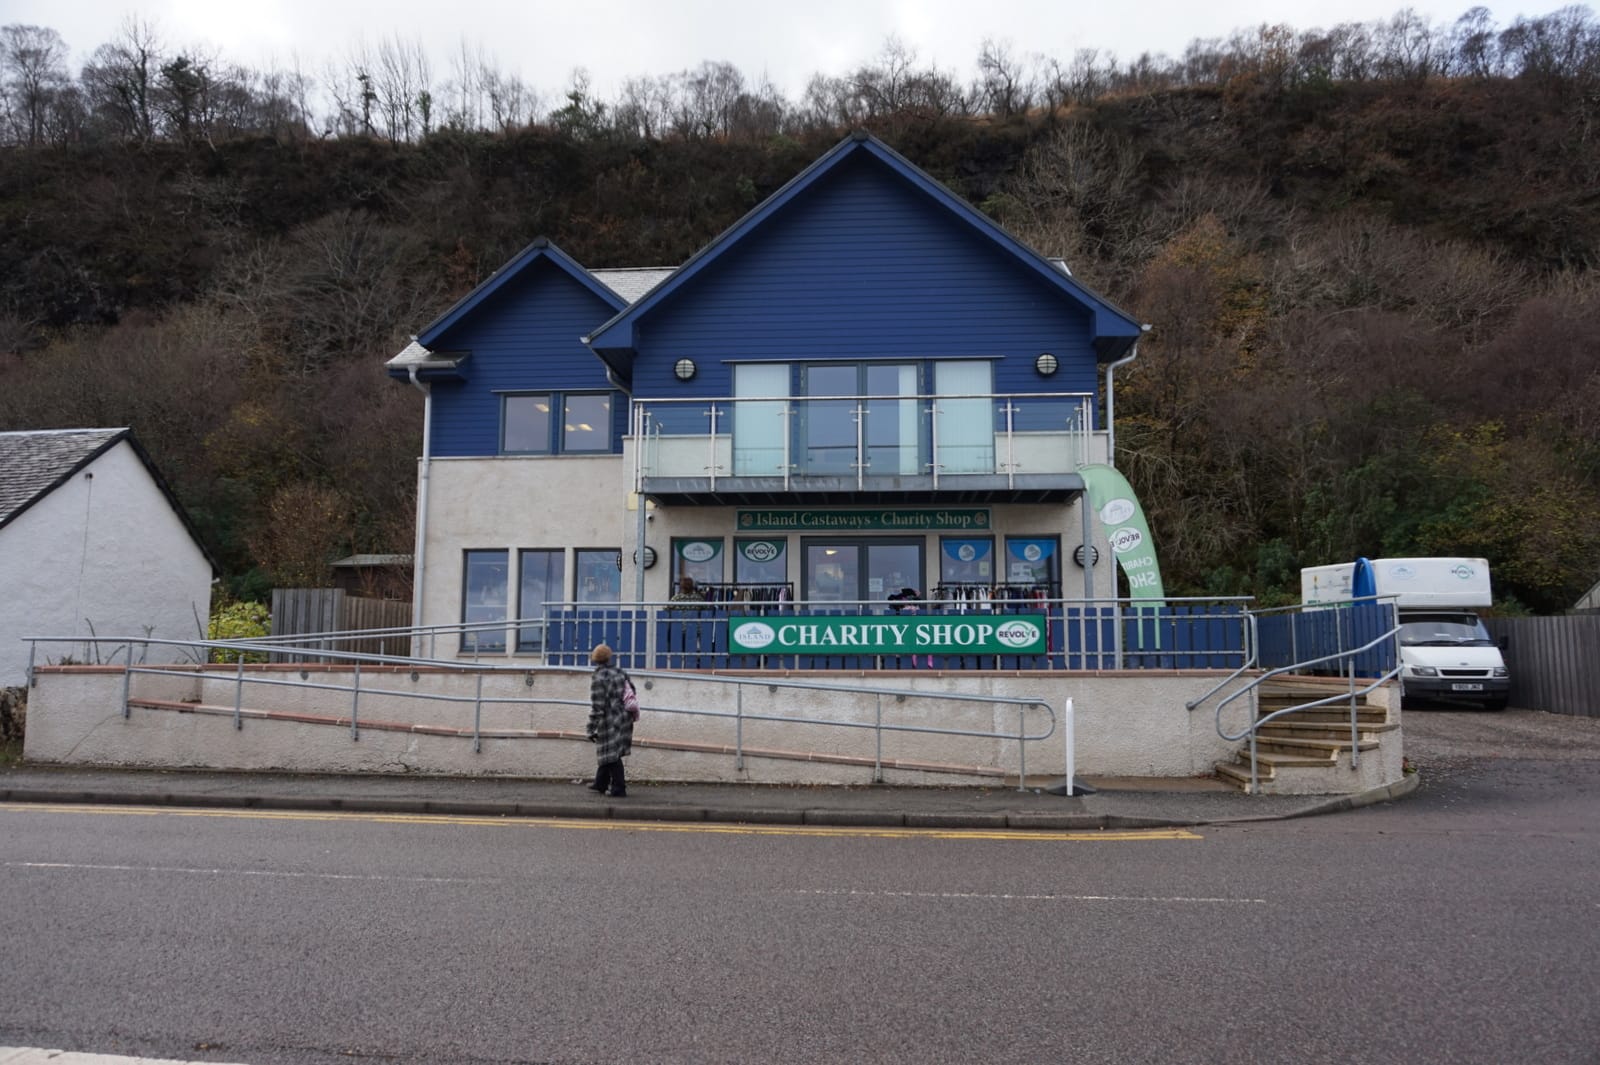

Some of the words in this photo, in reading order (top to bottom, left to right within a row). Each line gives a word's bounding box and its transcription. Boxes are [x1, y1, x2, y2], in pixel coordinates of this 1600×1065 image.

[757, 512, 797, 526] Island
[800, 511, 871, 528] Castaways
[881, 511, 932, 528] Charity
[936, 511, 971, 528] Shop
[777, 624, 909, 646] CHARITY
[915, 624, 993, 646] SHOP
